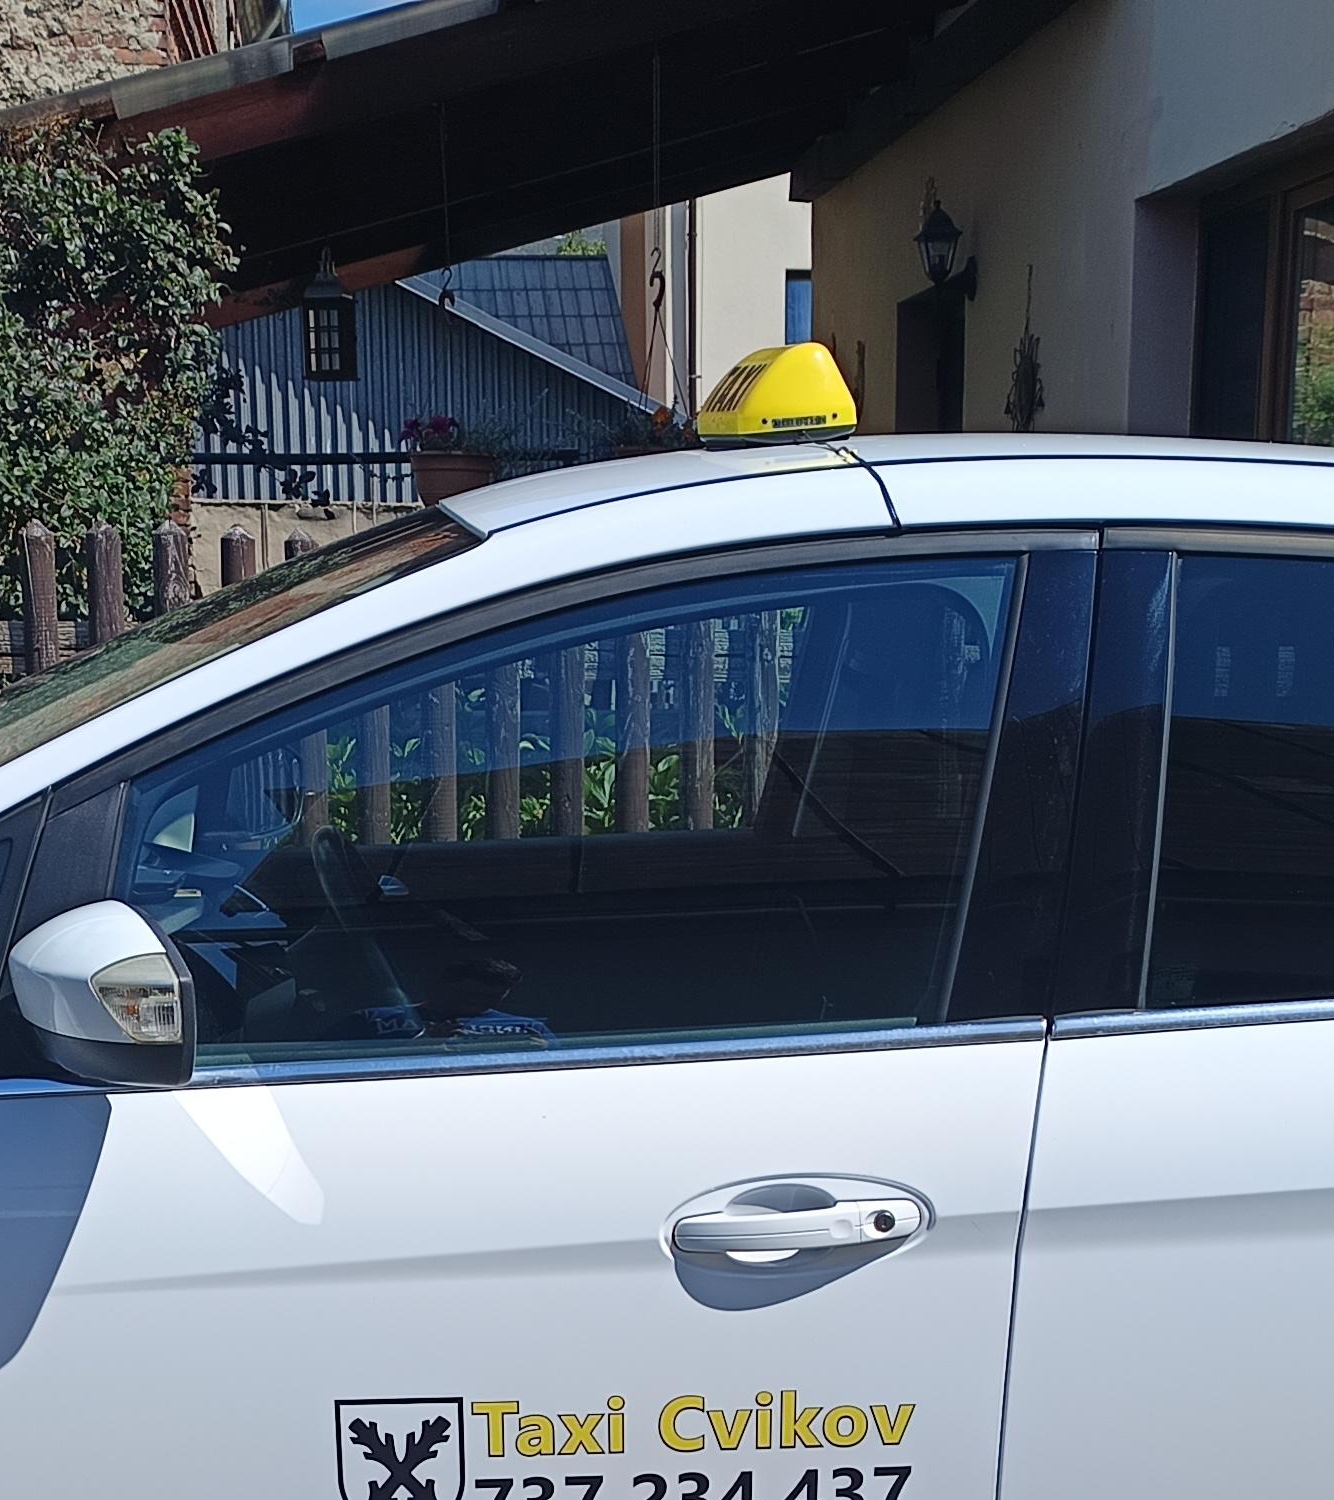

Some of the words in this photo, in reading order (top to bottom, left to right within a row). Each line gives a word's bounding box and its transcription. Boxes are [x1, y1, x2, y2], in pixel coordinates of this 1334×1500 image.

[706, 363, 768, 412] TAXI
[471, 1395, 625, 1457] Taxi
[658, 1390, 916, 1451] Cvikov
